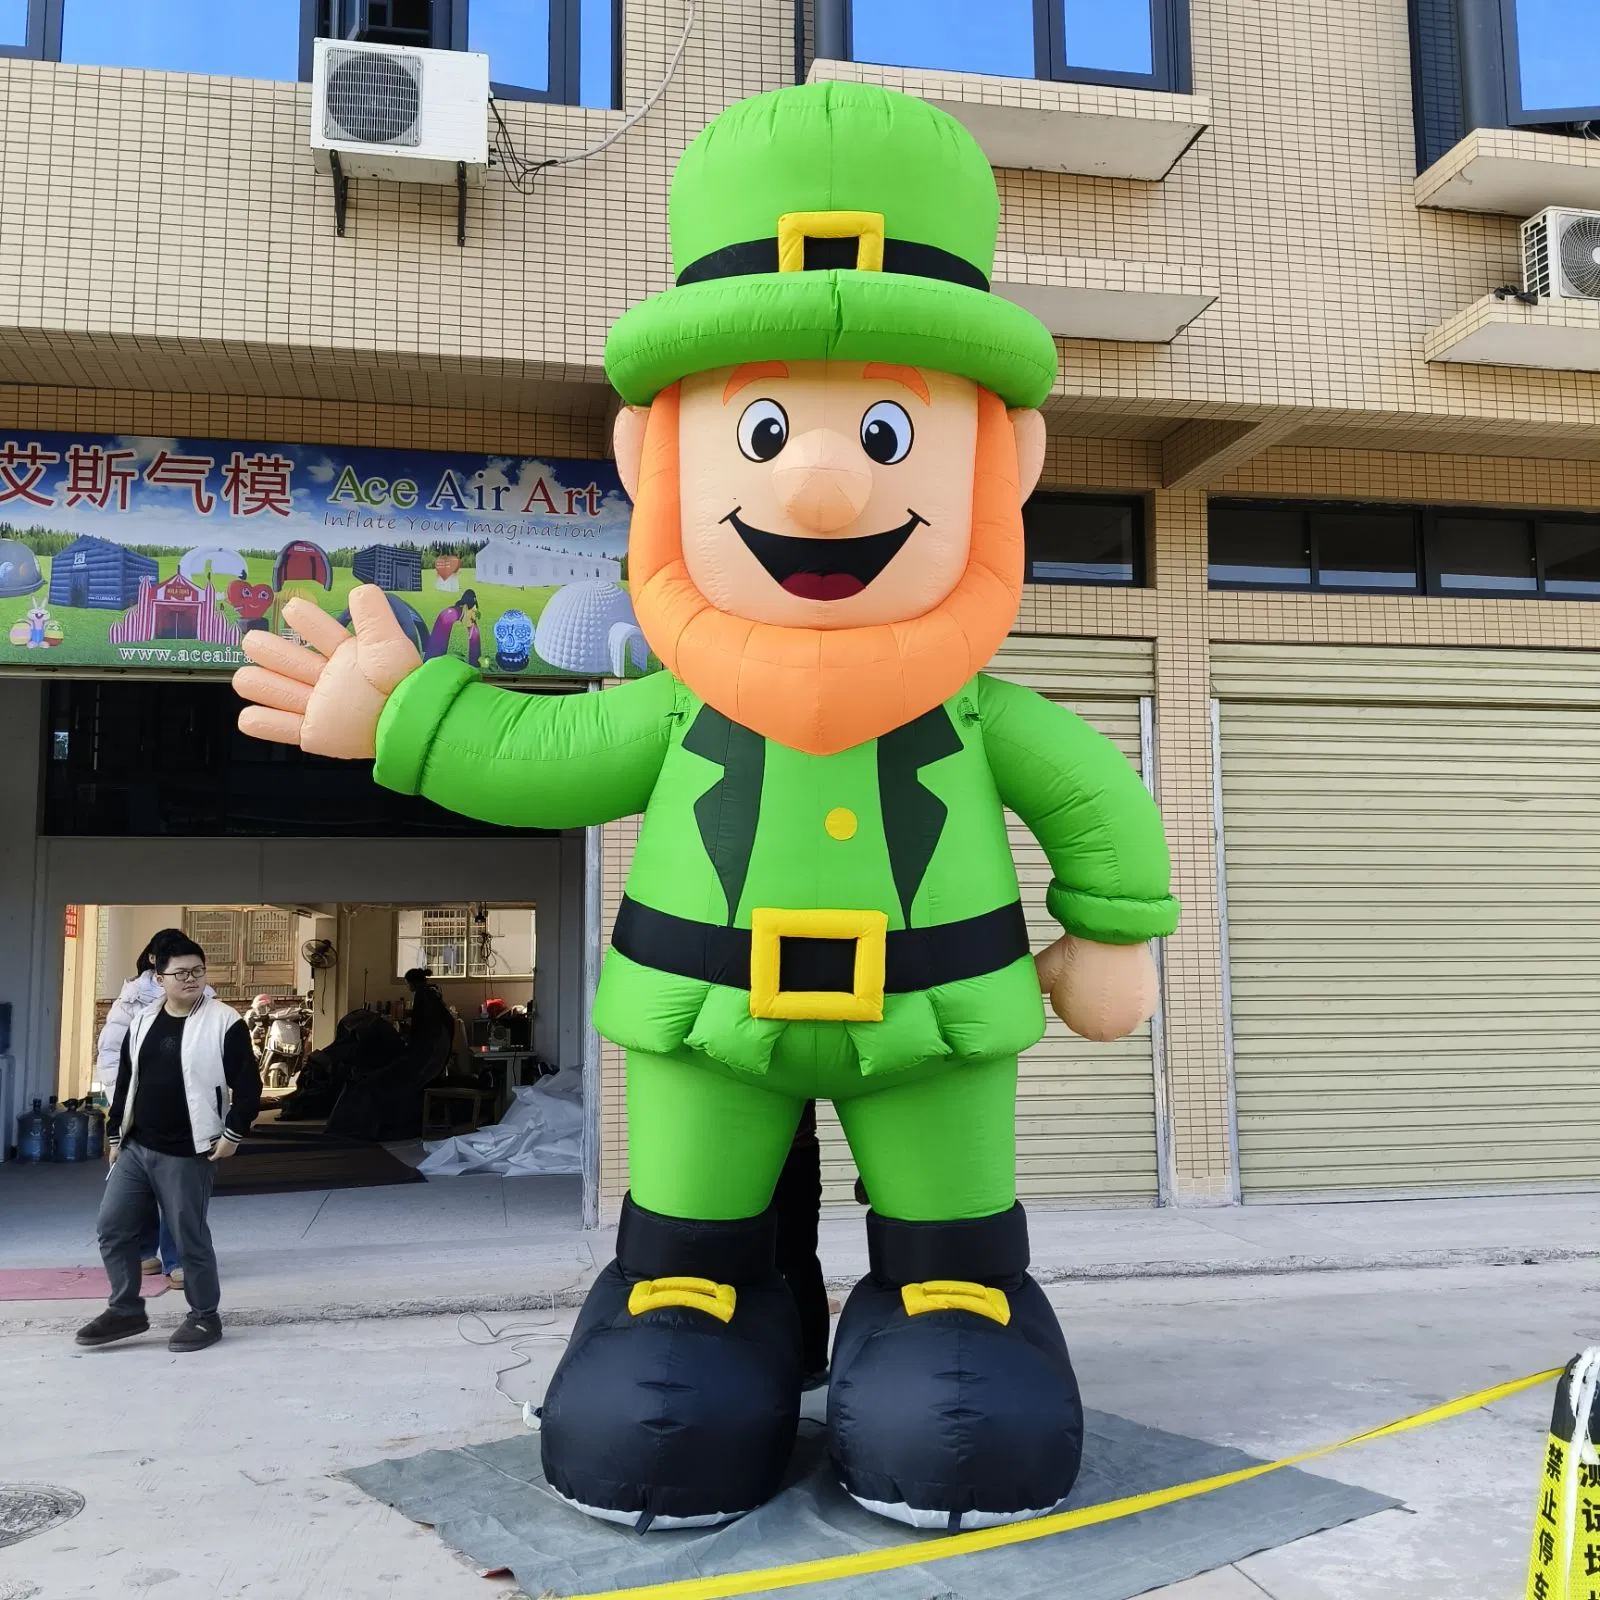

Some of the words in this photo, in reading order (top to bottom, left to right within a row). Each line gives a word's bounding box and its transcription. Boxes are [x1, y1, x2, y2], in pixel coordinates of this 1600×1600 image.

[0, 442, 294, 517] 艾斯气模
[327, 465, 417, 507] Ace
[427, 469, 511, 511] Air
[521, 476, 603, 516] Art
[323, 510, 397, 530] Inflate
[406, 515, 458, 532] Your
[465, 518, 603, 540] Imagination!
